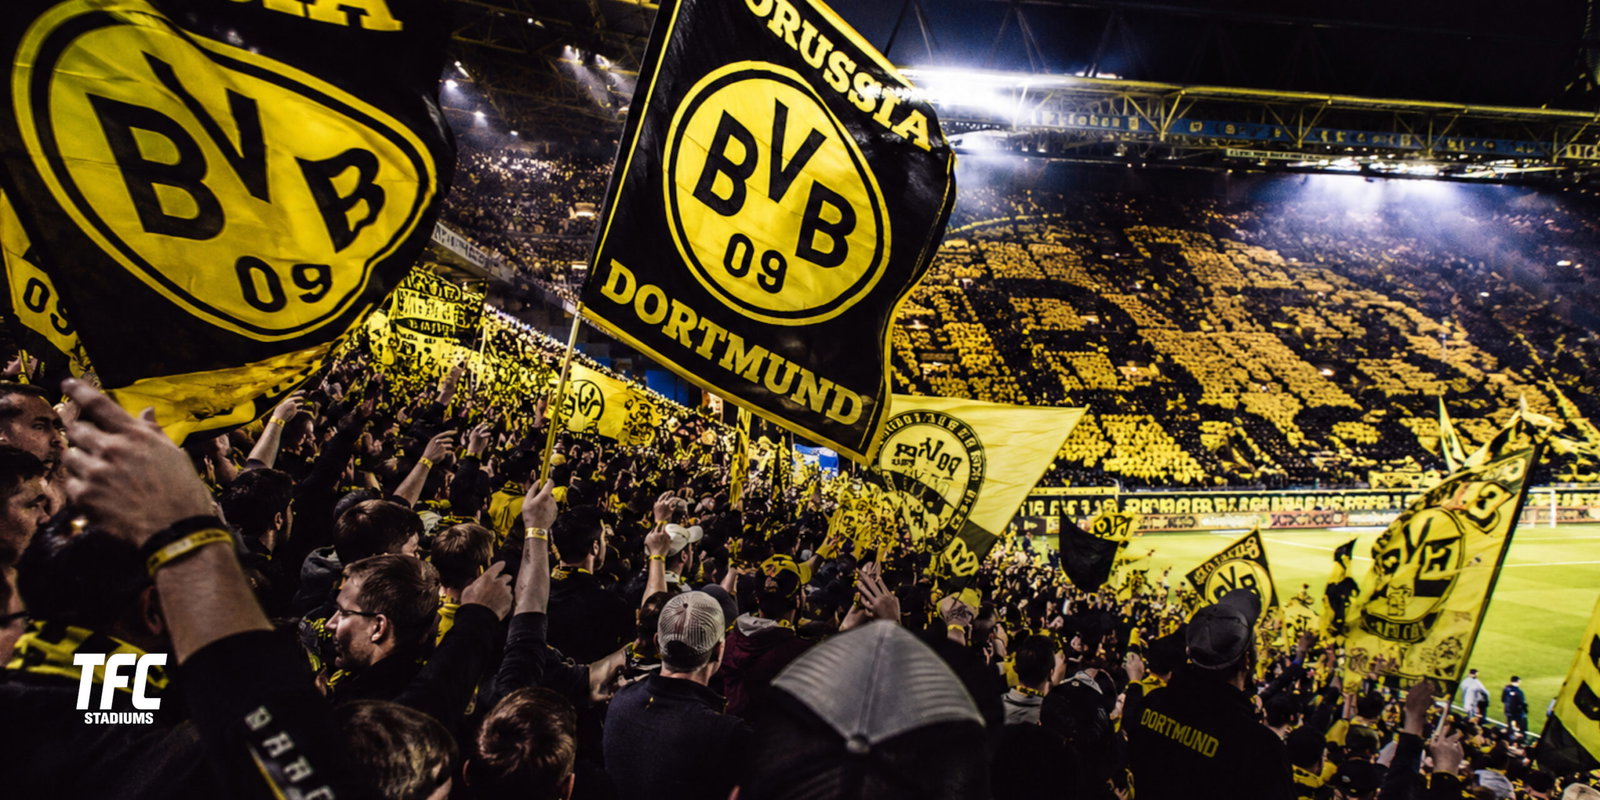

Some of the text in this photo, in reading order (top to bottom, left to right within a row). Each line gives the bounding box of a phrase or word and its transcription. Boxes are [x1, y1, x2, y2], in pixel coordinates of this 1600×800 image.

[86, 50, 385, 253] BVB
[692, 97, 857, 268] BVB
[235, 256, 332, 312] 09
[723, 233, 788, 294] 09
[600, 258, 864, 426] DORTMUND
[1141, 708, 1219, 758] DORTMUND
